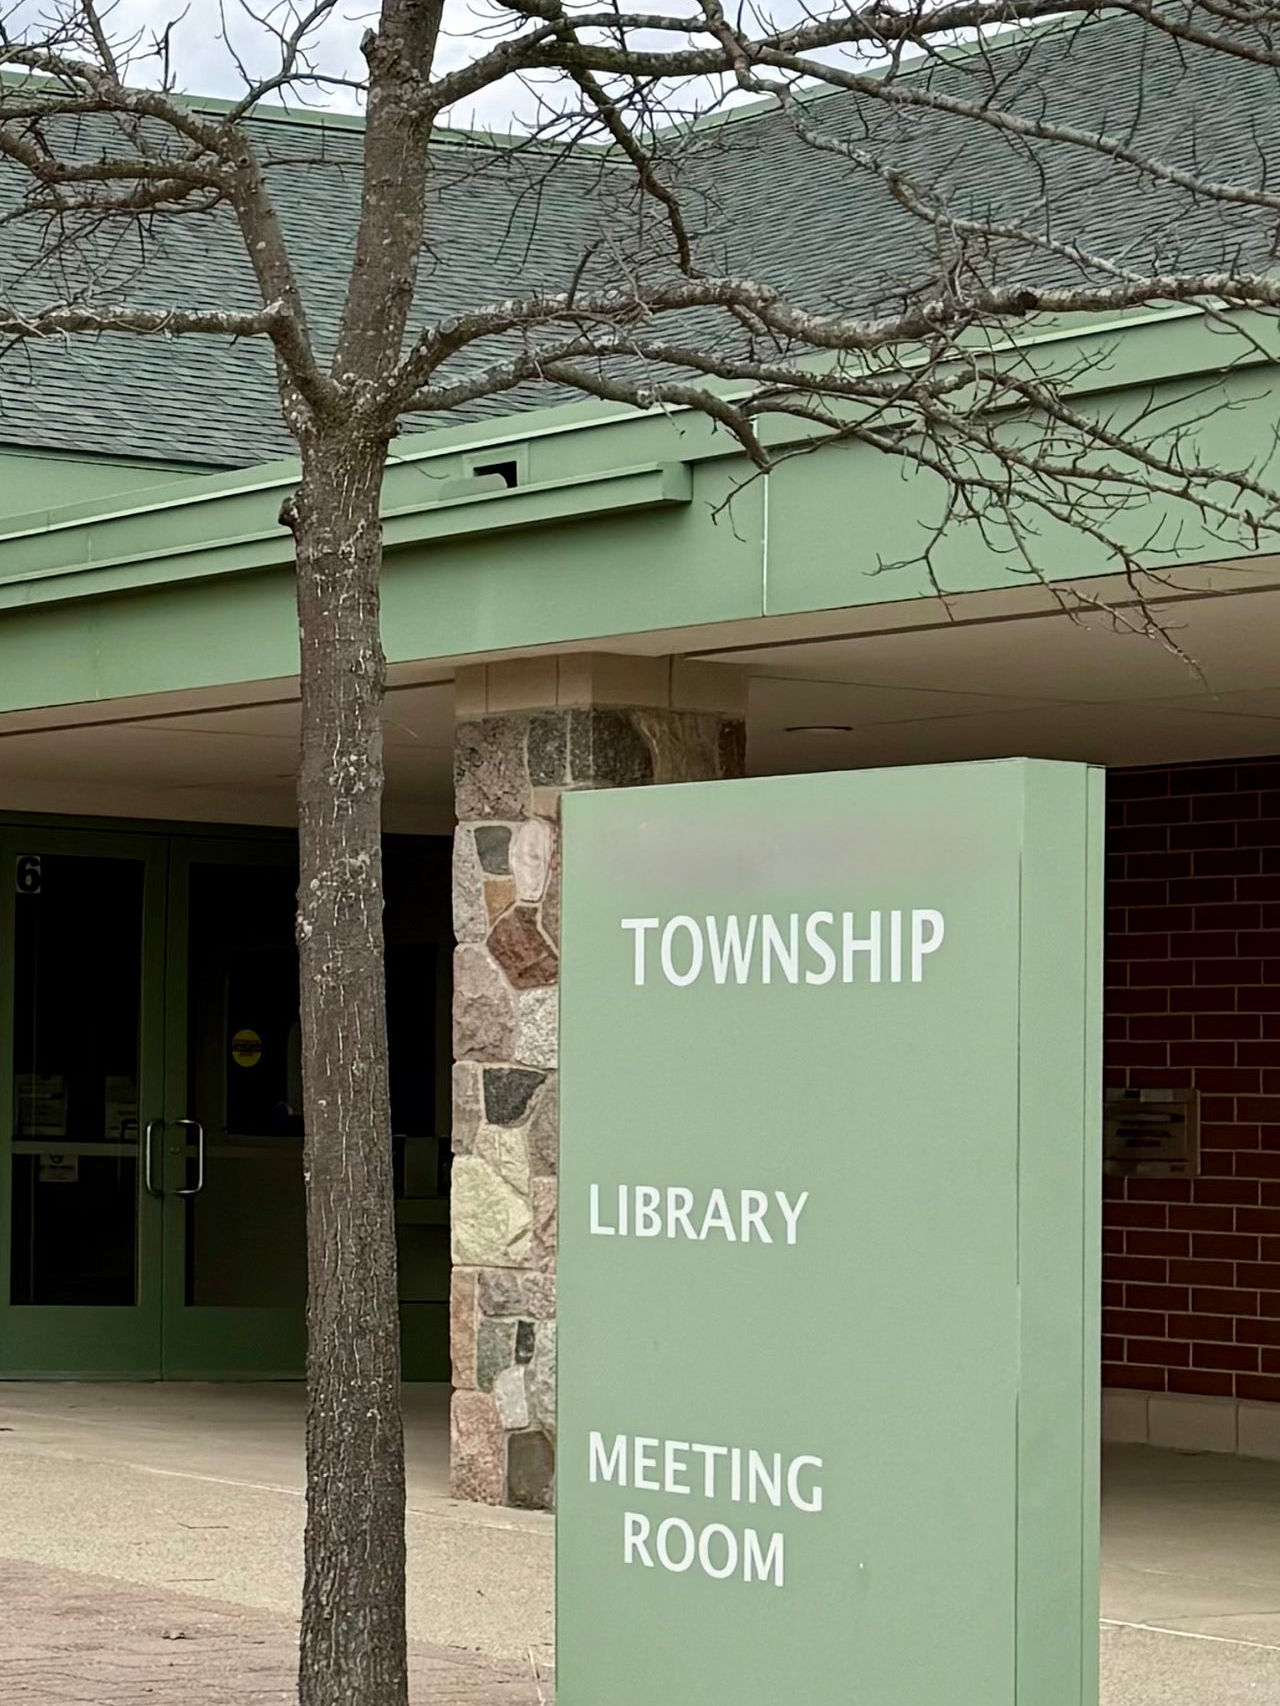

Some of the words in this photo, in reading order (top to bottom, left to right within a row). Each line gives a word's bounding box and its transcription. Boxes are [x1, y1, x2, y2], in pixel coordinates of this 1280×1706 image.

[621, 909, 945, 987] TOWNSHIP
[590, 1183, 809, 1245] LIBRARY
[589, 1431, 823, 1512] MEETING
[624, 1511, 784, 1587] ROOM
